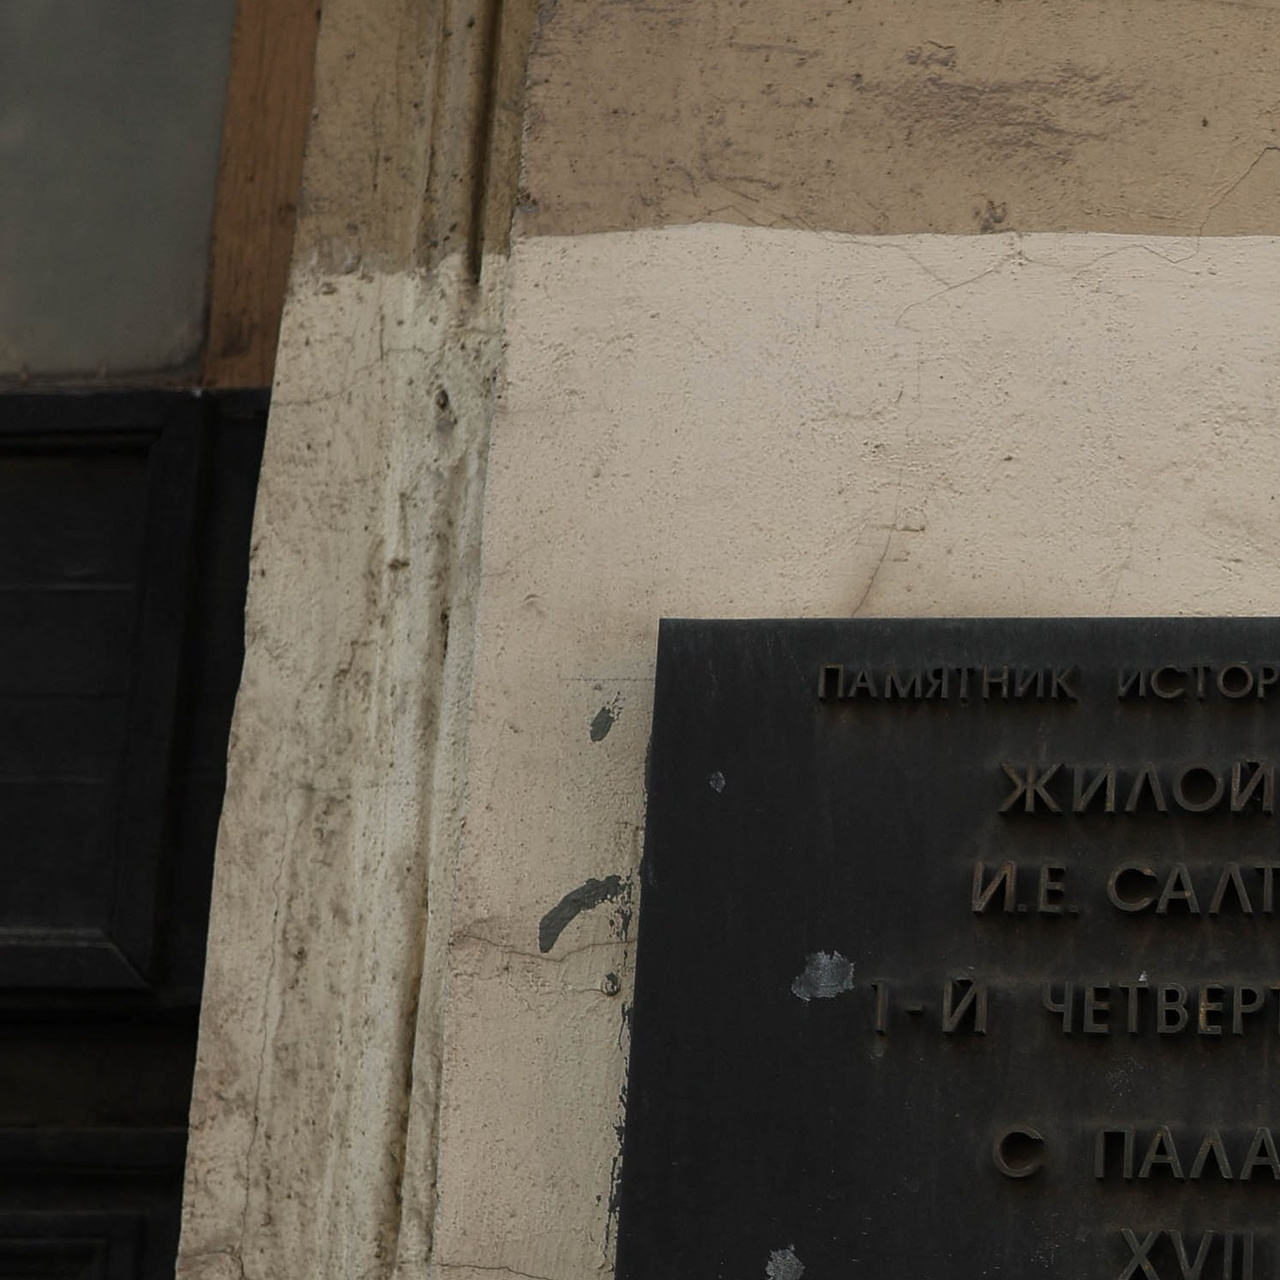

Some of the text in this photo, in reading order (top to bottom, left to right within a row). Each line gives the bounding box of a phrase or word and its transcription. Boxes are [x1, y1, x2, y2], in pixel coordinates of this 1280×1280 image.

[818, 663, 1079, 700] ПАМЯТНИК
[998, 759, 1275, 817] ЖИЛОЙ
[871, 970, 988, 1035] 1-Й
[993, 1123, 1046, 1179] С
